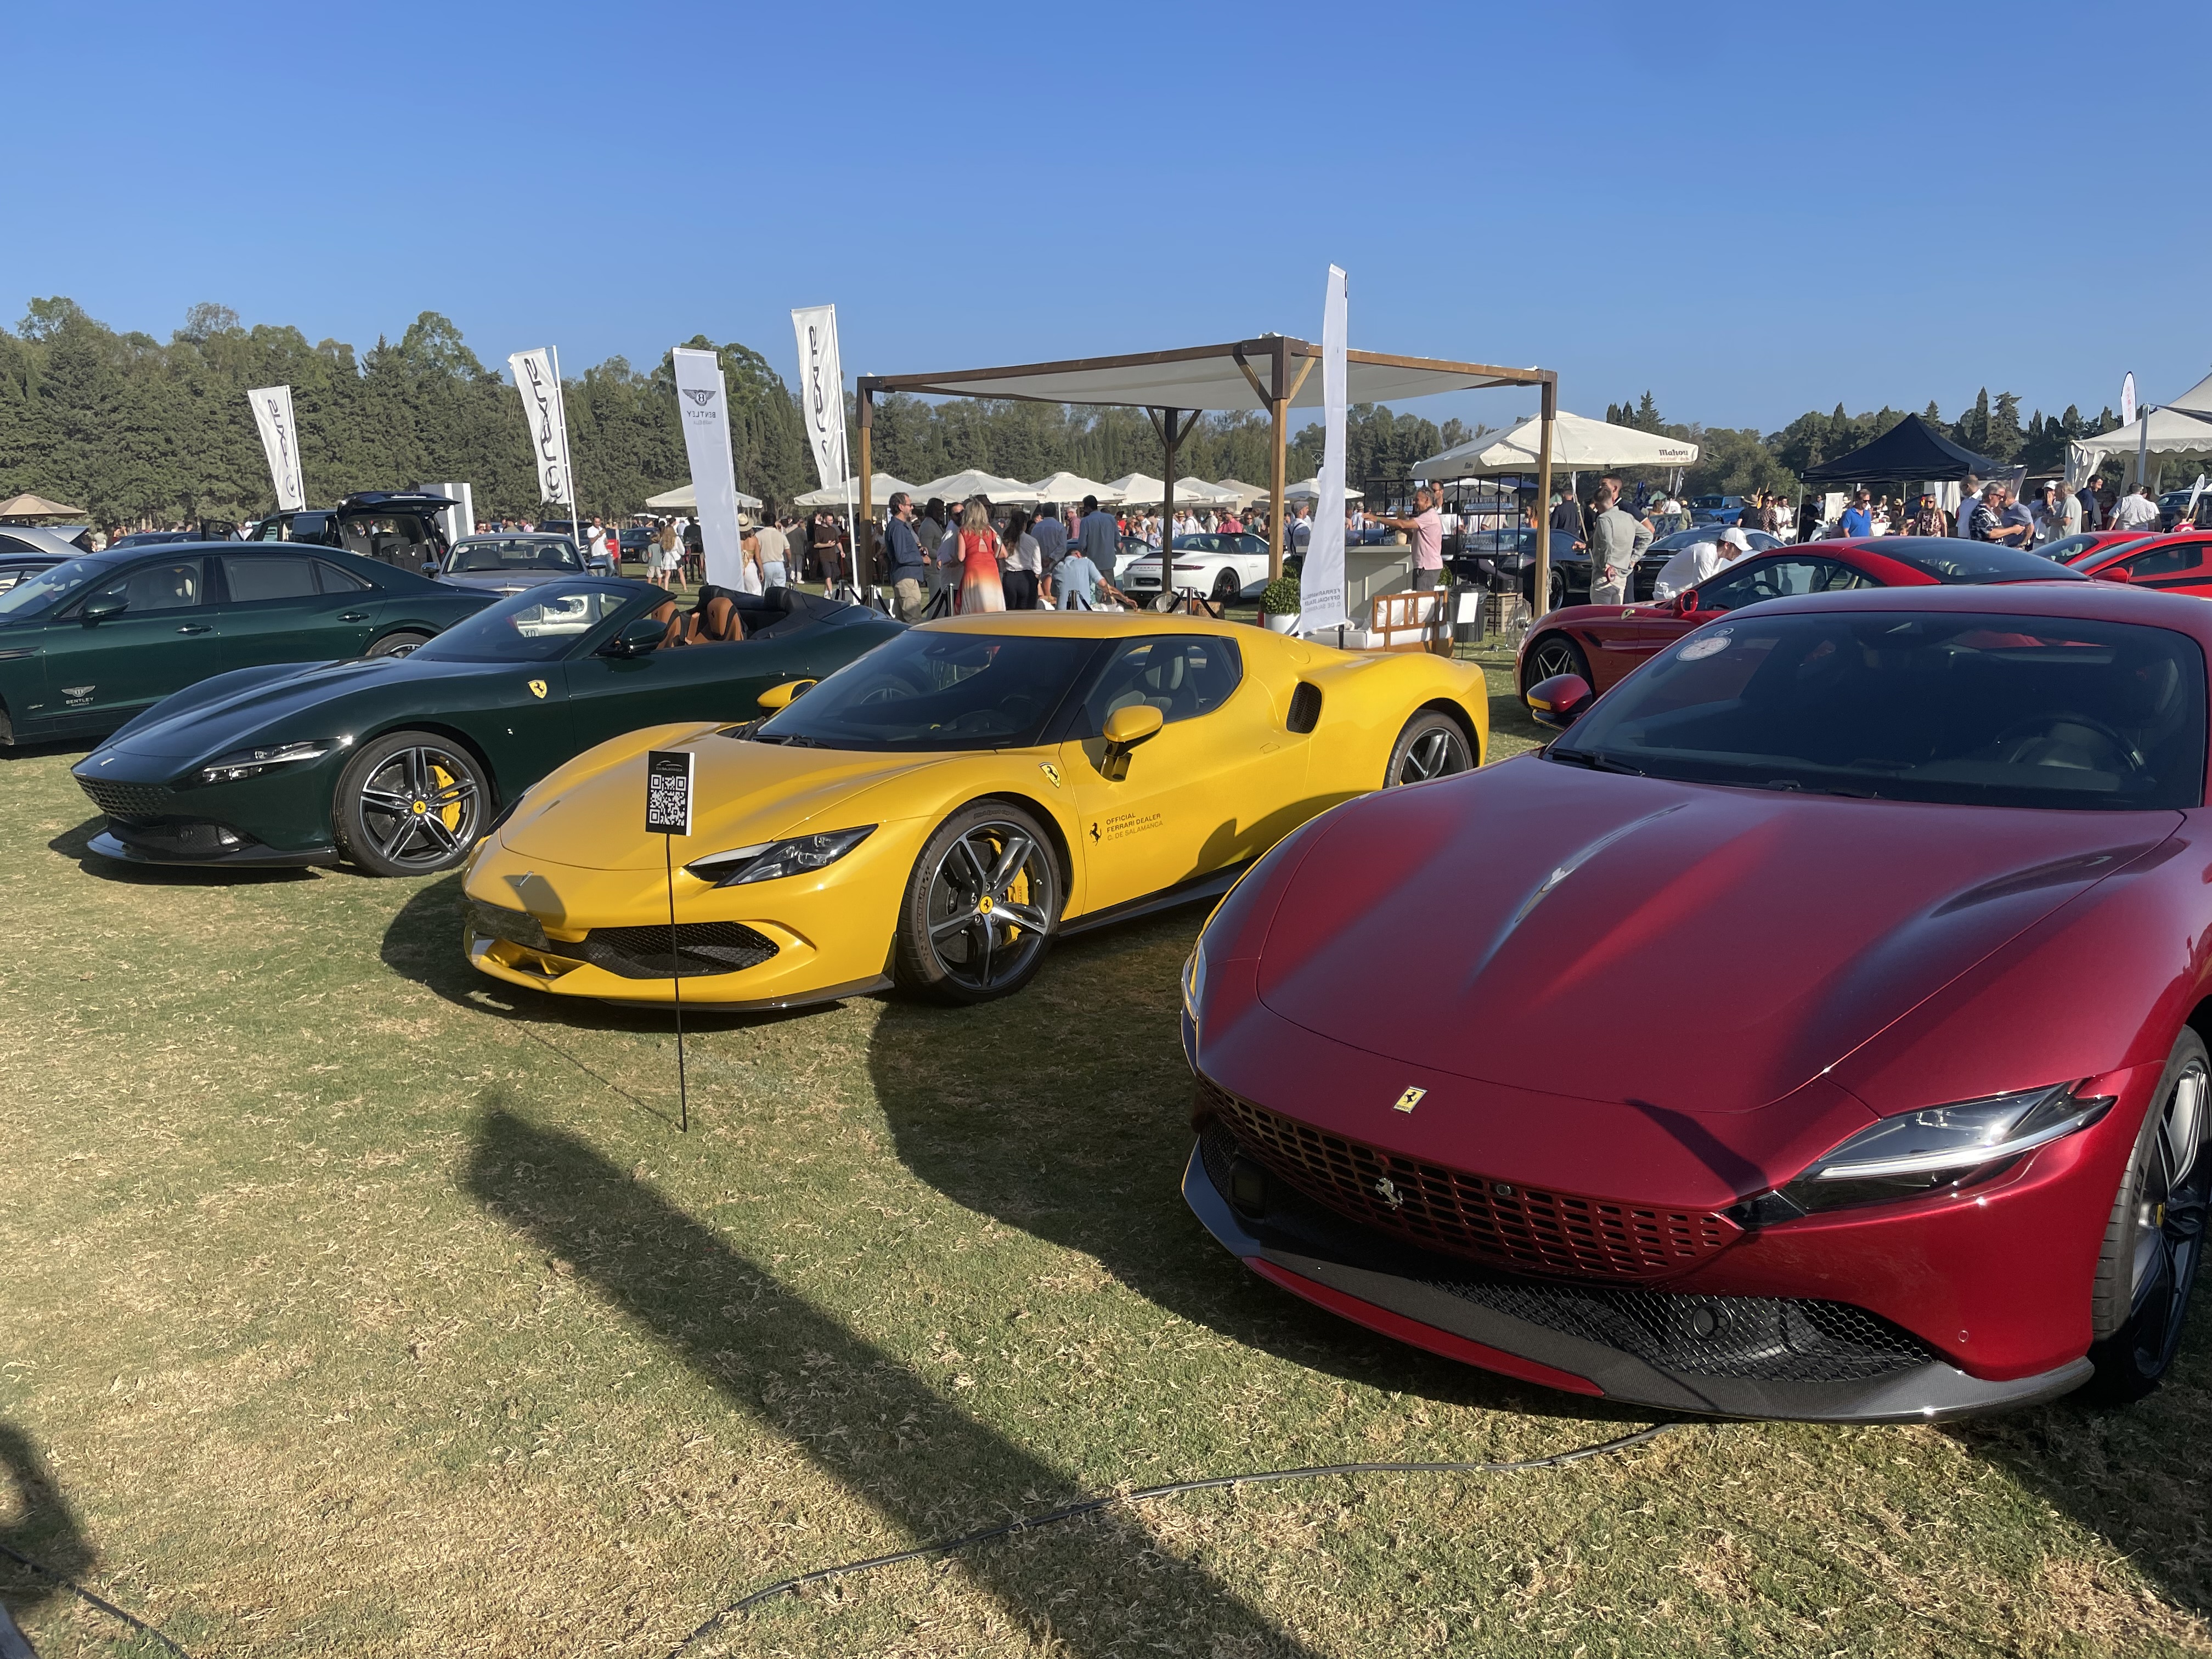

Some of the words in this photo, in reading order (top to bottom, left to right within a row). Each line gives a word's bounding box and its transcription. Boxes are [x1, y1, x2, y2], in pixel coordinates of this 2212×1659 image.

[66, 697, 94, 705] BENTLEY
[1106, 812, 1136, 825] OFFICIAL
[1107, 822, 1135, 833] FERRARI
[1136, 813, 1161, 825] DEALER
[1125, 820, 1163, 837] SALAMANCA
[917, 886, 927, 931] MICHELIN
